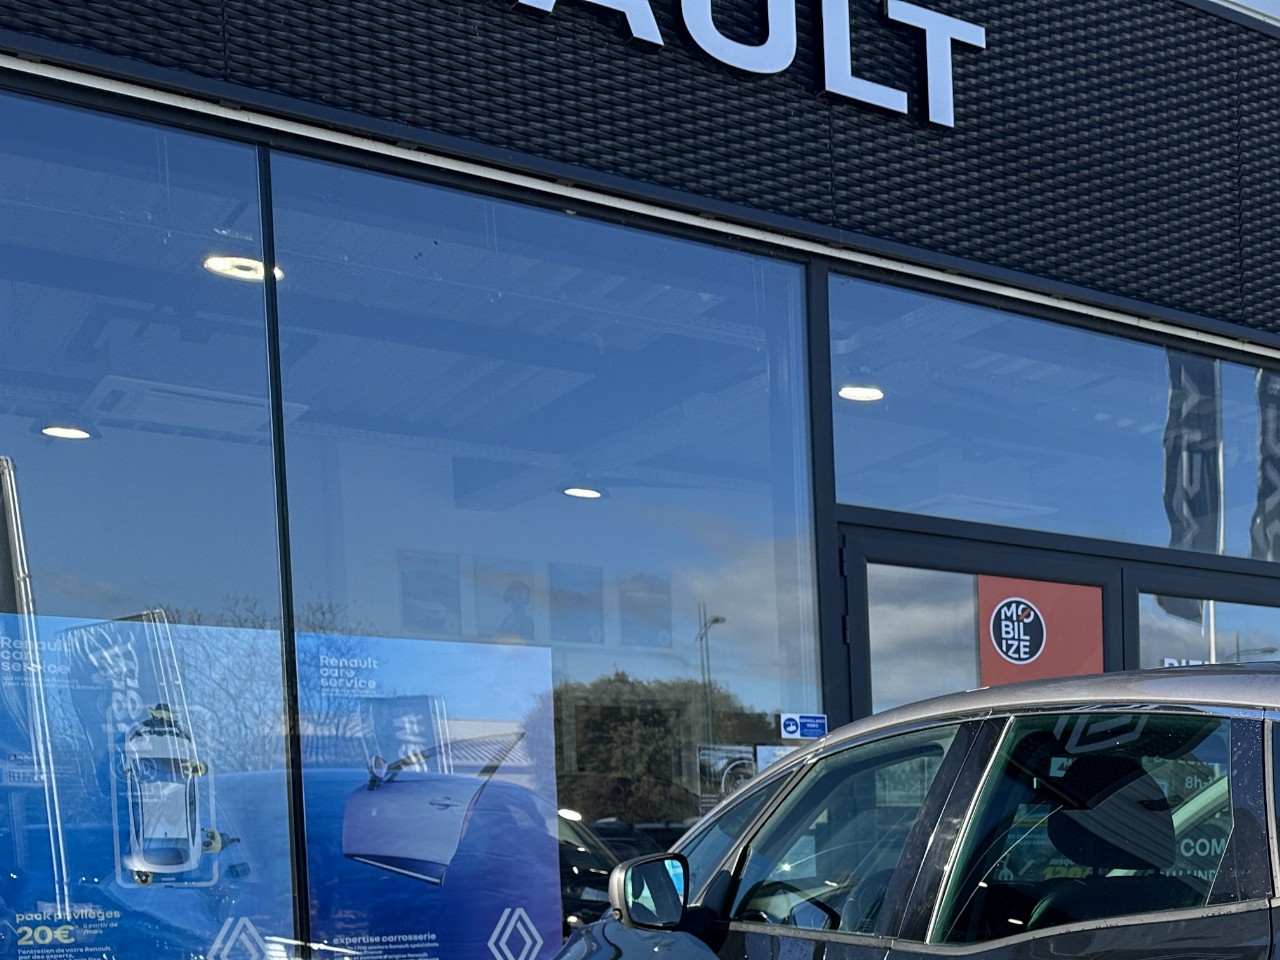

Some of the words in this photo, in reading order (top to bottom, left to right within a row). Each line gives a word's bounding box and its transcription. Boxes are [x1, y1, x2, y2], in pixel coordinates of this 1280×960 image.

[518, 0, 986, 127] ULT
[320, 655, 379, 669] Renault
[320, 667, 356, 677] care
[320, 676, 377, 689] service
[15, 911, 51, 923] pack
[333, 934, 380, 945] expertise
[382, 932, 437, 943] carrosserie
